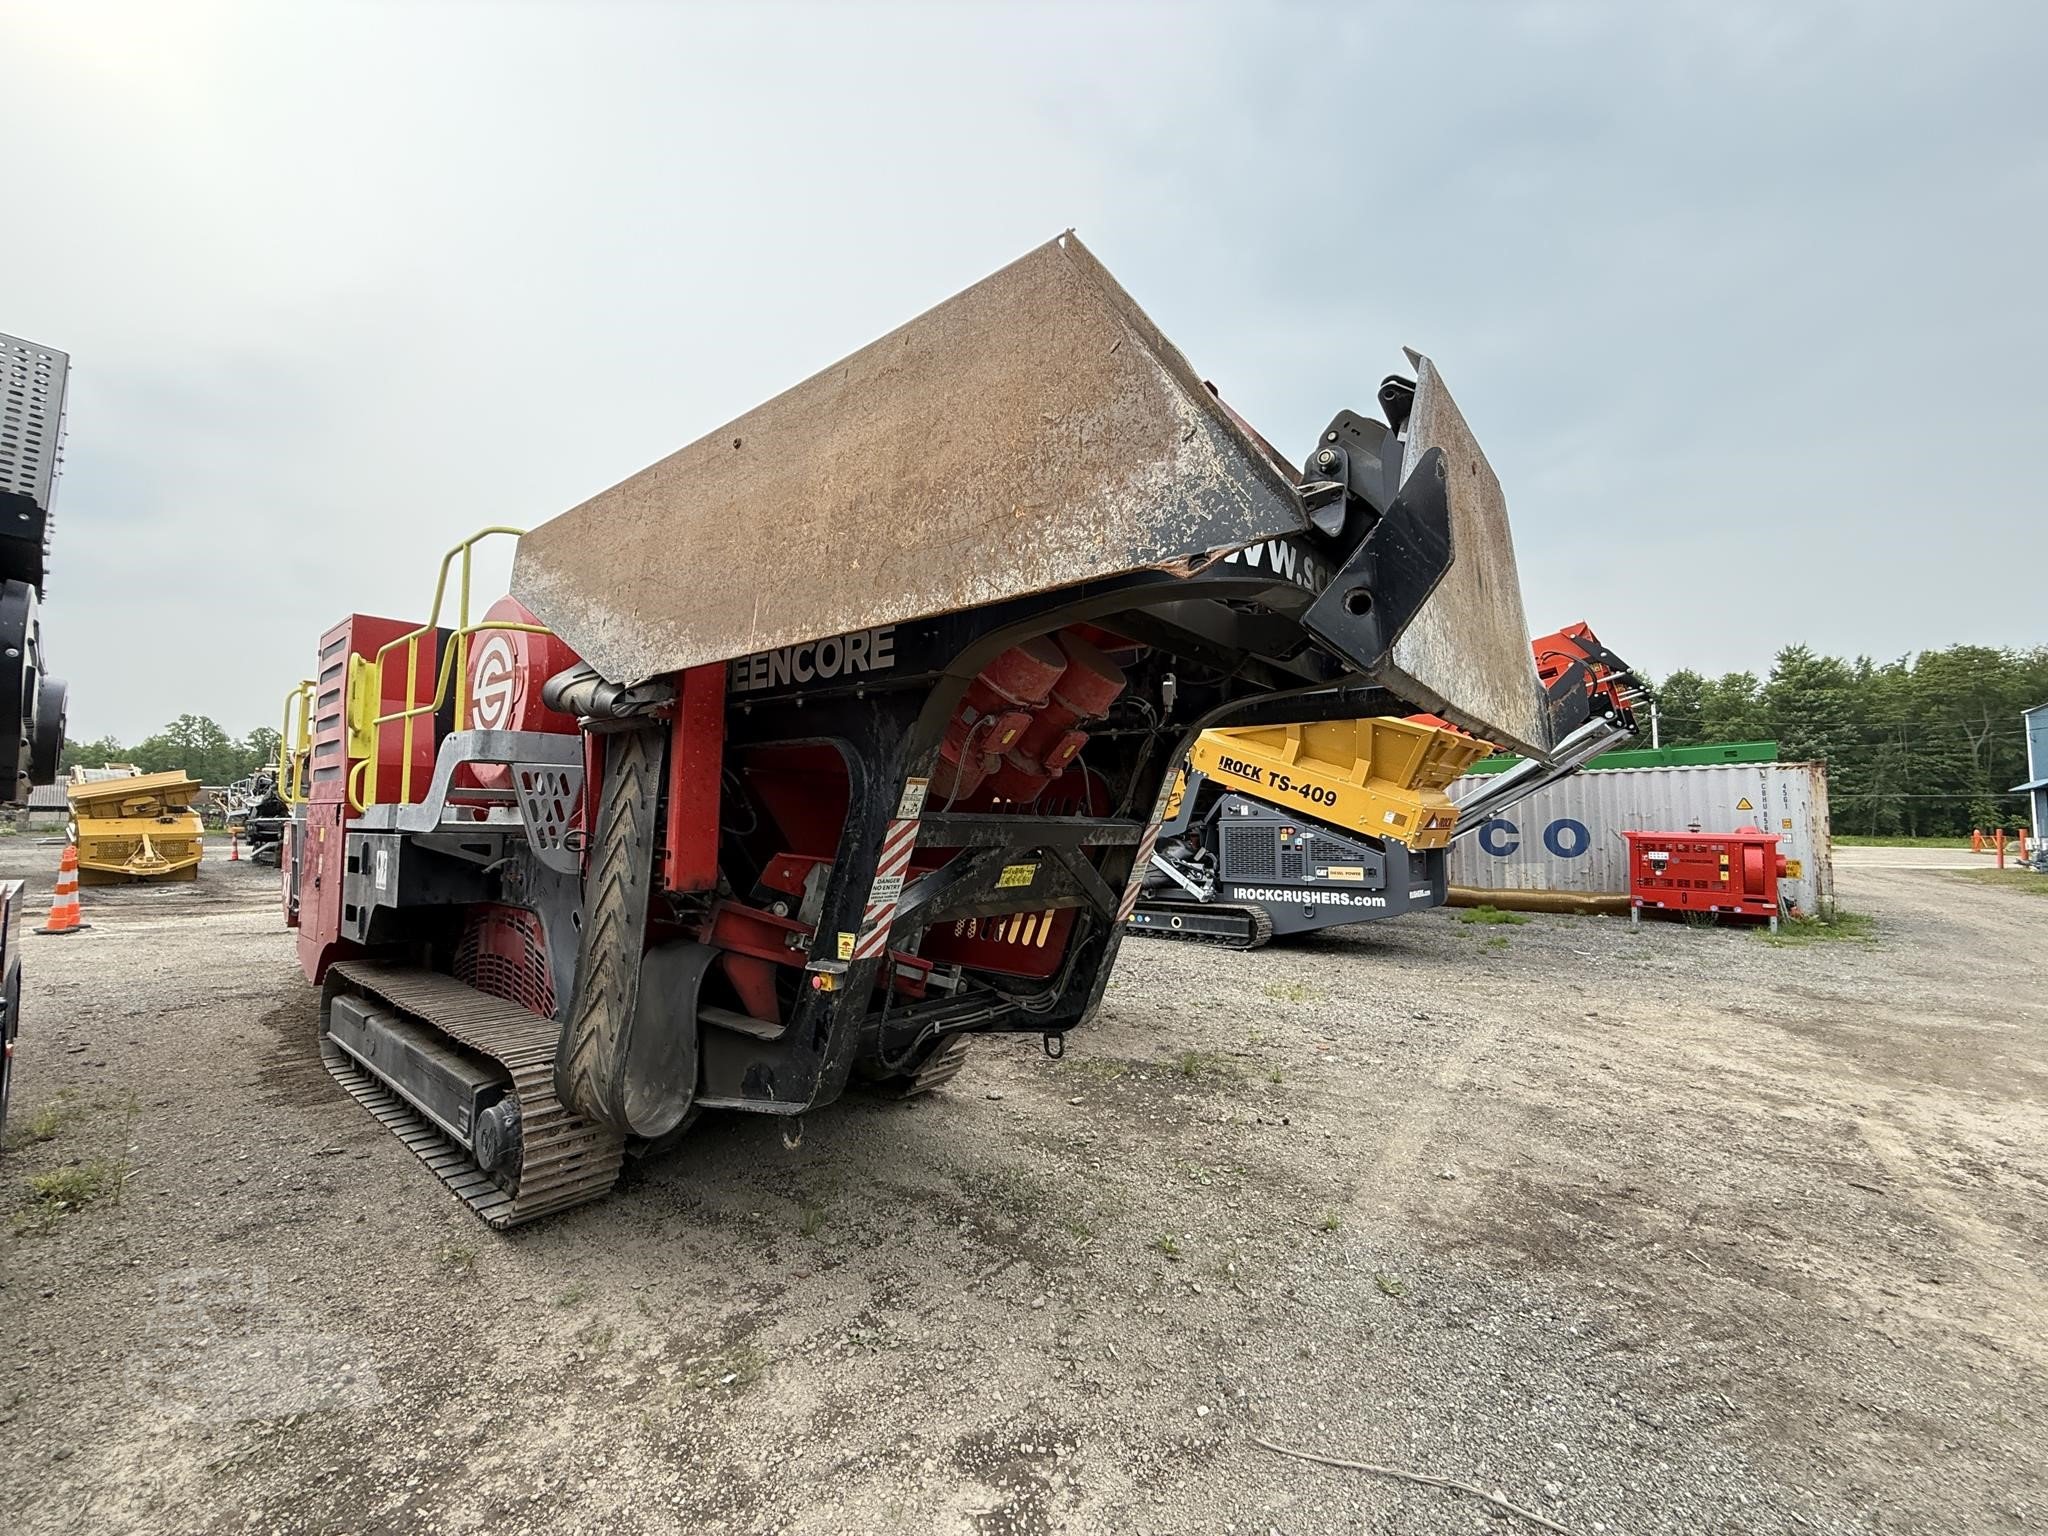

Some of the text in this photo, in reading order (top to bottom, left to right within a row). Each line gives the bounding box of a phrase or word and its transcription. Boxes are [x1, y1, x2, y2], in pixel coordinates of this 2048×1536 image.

[1217, 756, 1337, 806] IROCK TS-409
[1233, 888, 1386, 907] IROCKCRUSHERS.com
